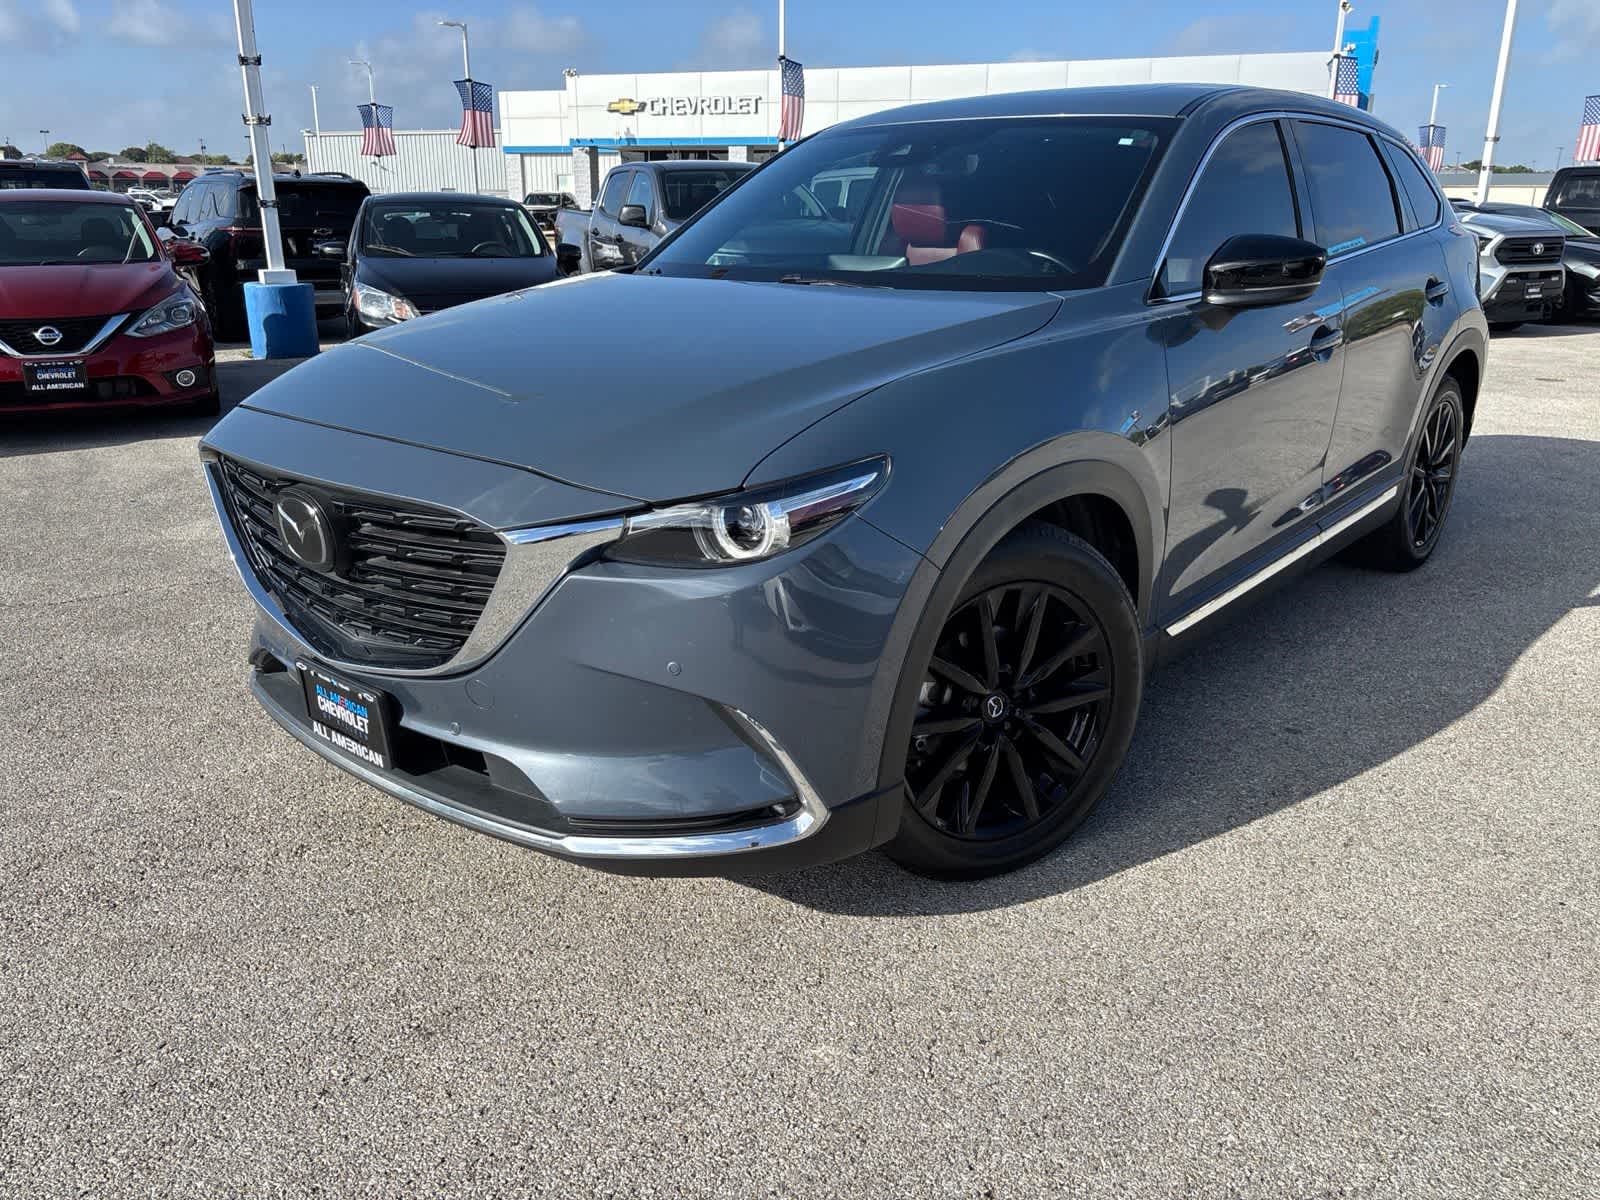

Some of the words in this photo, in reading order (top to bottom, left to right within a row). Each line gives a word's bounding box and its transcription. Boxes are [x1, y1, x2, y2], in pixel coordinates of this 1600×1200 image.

[648, 96, 762, 116] CHEVROLET
[37, 371, 76, 380] CHEVROLET
[47, 382, 84, 390] AMERICAN
[316, 684, 329, 699] ALL
[328, 691, 368, 719] AMERICAN
[317, 695, 369, 734] CHEVROLET
[313, 720, 331, 741] ALL
[331, 730, 384, 768] AMERICAN
